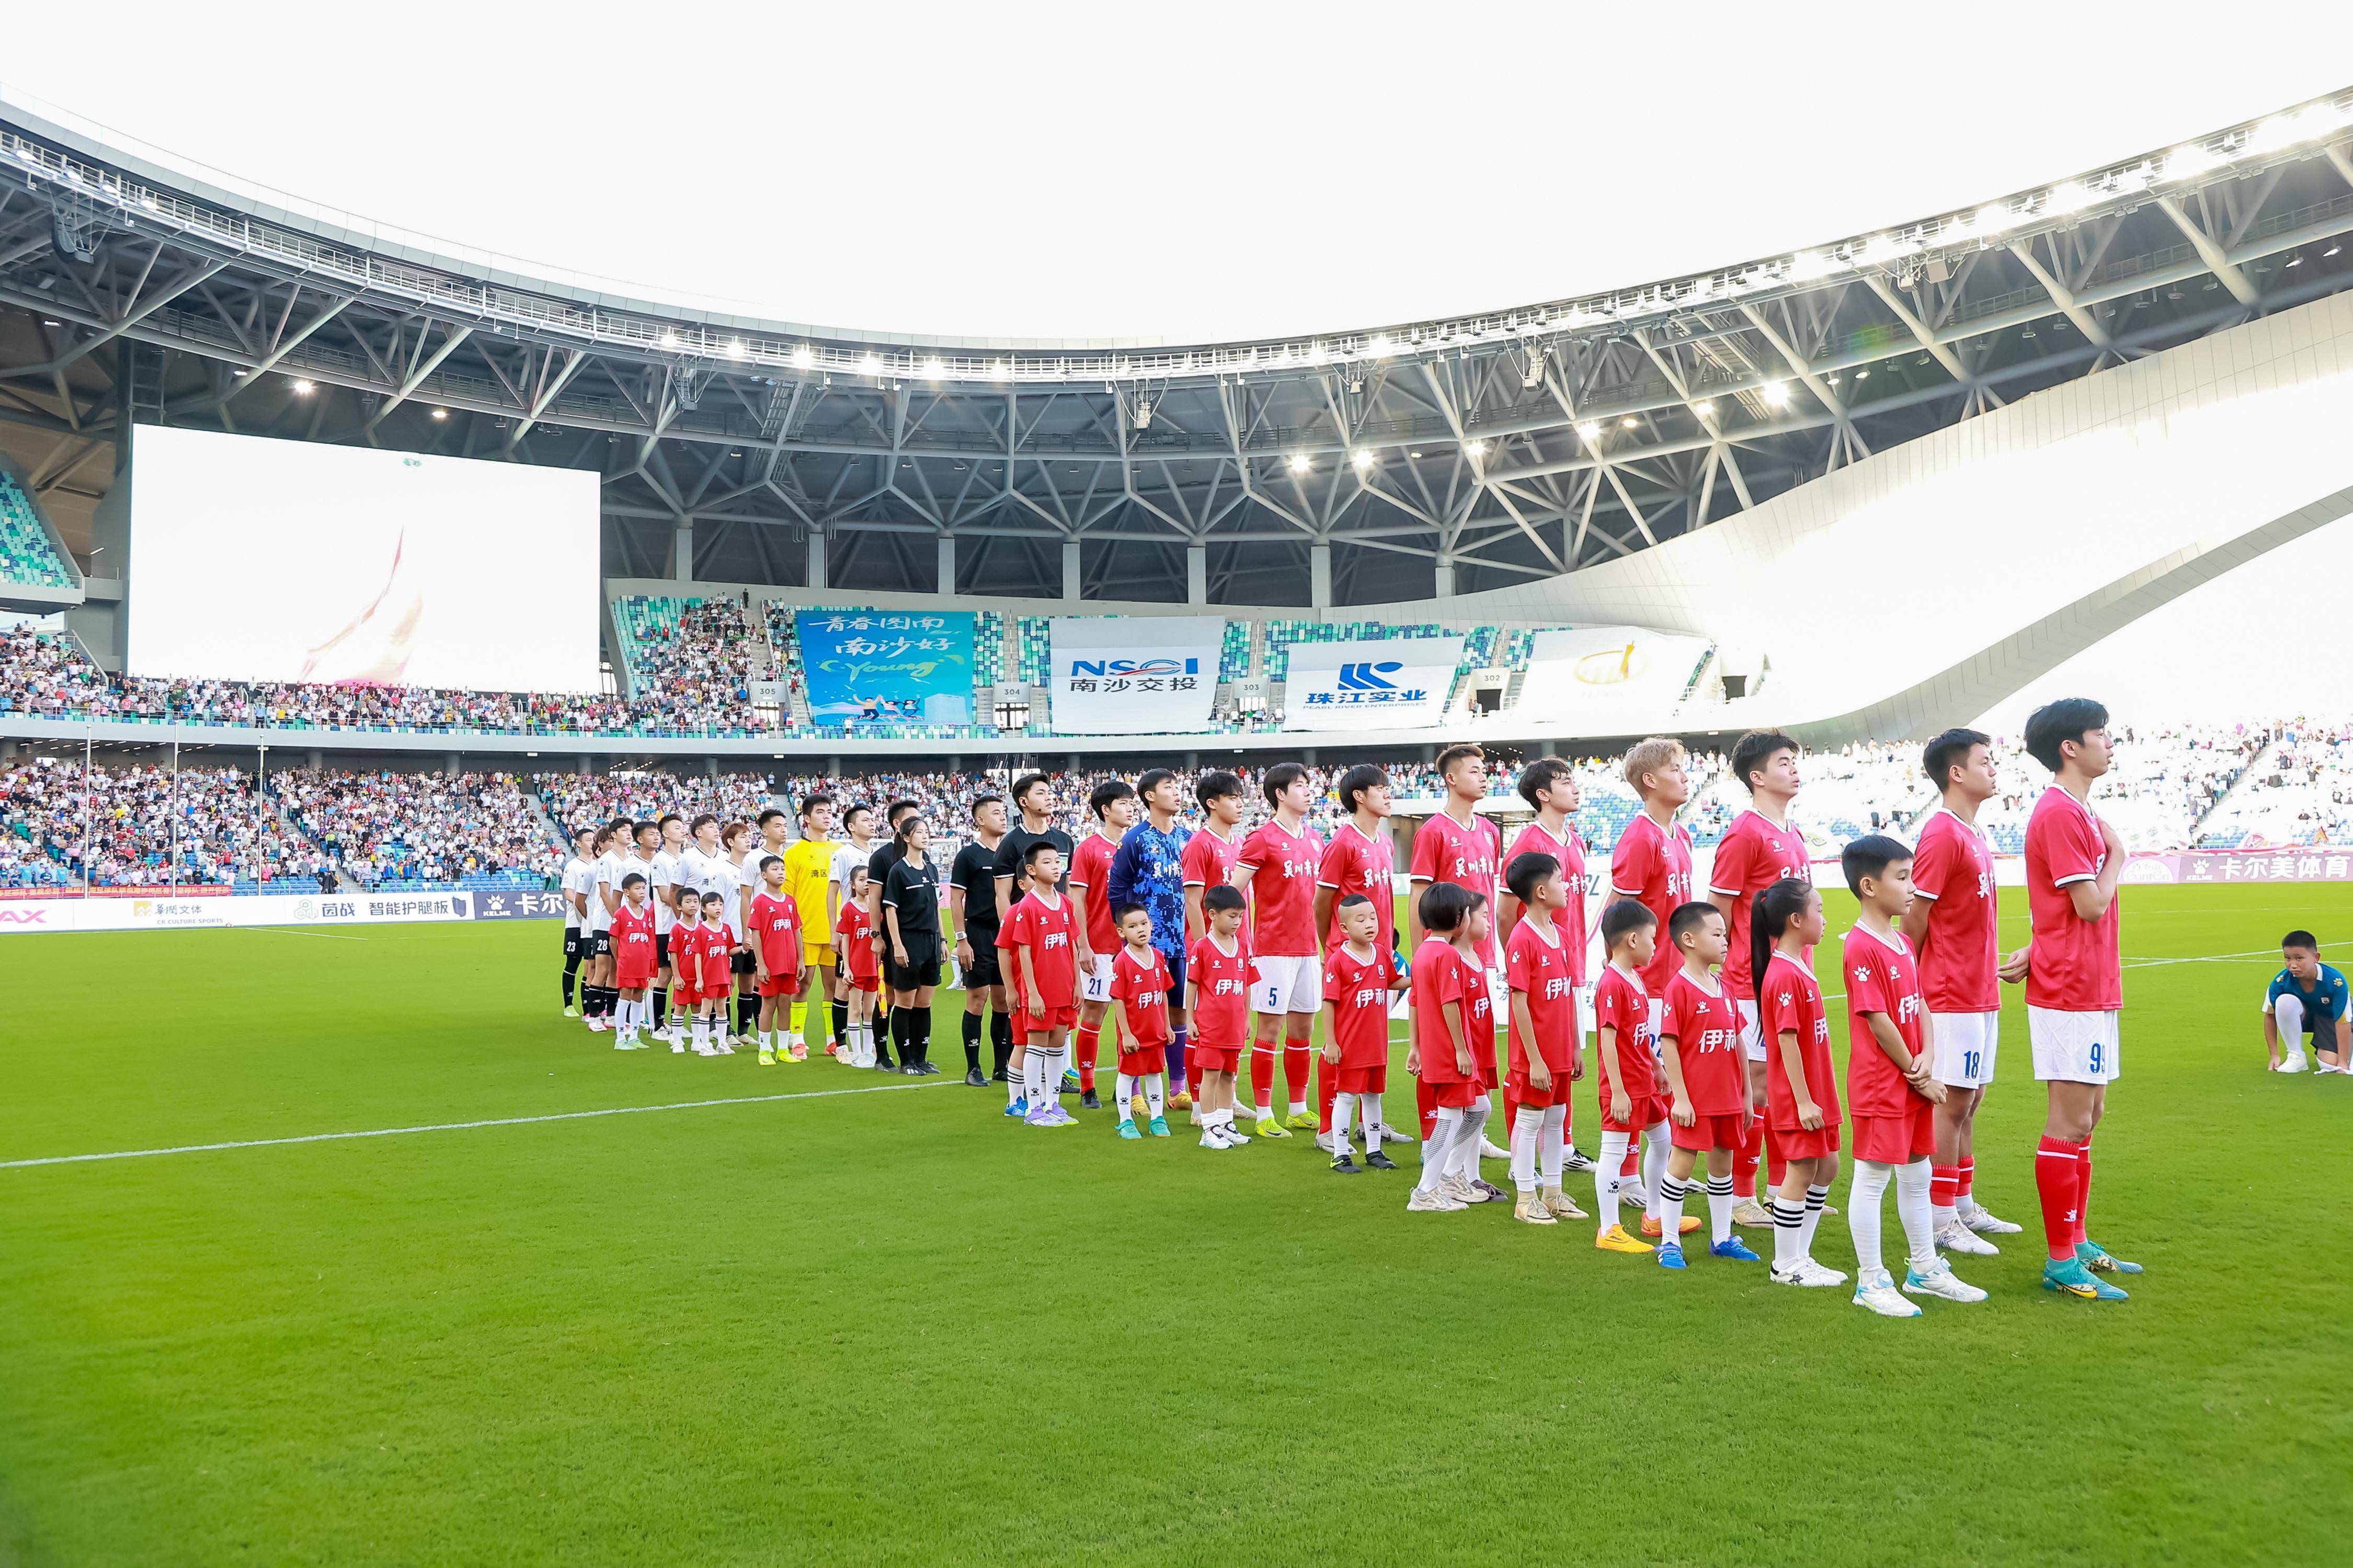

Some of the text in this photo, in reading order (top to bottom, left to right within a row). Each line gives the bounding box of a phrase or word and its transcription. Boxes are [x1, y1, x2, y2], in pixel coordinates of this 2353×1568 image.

[835, 636, 956, 658] 南沙好
[1070, 677, 1198, 693] 南沙交投
[1305, 690, 1427, 704] 珠江实业
[811, 869, 828, 878] 湾区
[2219, 855, 2351, 880] 卡尔美体育
[322, 902, 355, 917] 茵战
[369, 900, 449, 915] 智能护腿板
[515, 892, 565, 915] 卡尔
[773, 919, 792, 931] 伊利
[597, 940, 608, 951] 28
[629, 932, 648, 943] 伊利
[1045, 931, 1068, 950] 伊利
[567, 942, 576, 952] 23
[709, 945, 727, 958] 伊利
[1088, 978, 1101, 995] 21
[1215, 979, 1243, 996] 伊利
[1138, 989, 1162, 1009] 伊利
[1269, 987, 1277, 1006] 5
[1355, 988, 1385, 1009] 伊利
[1964, 1050, 1980, 1079] 18
